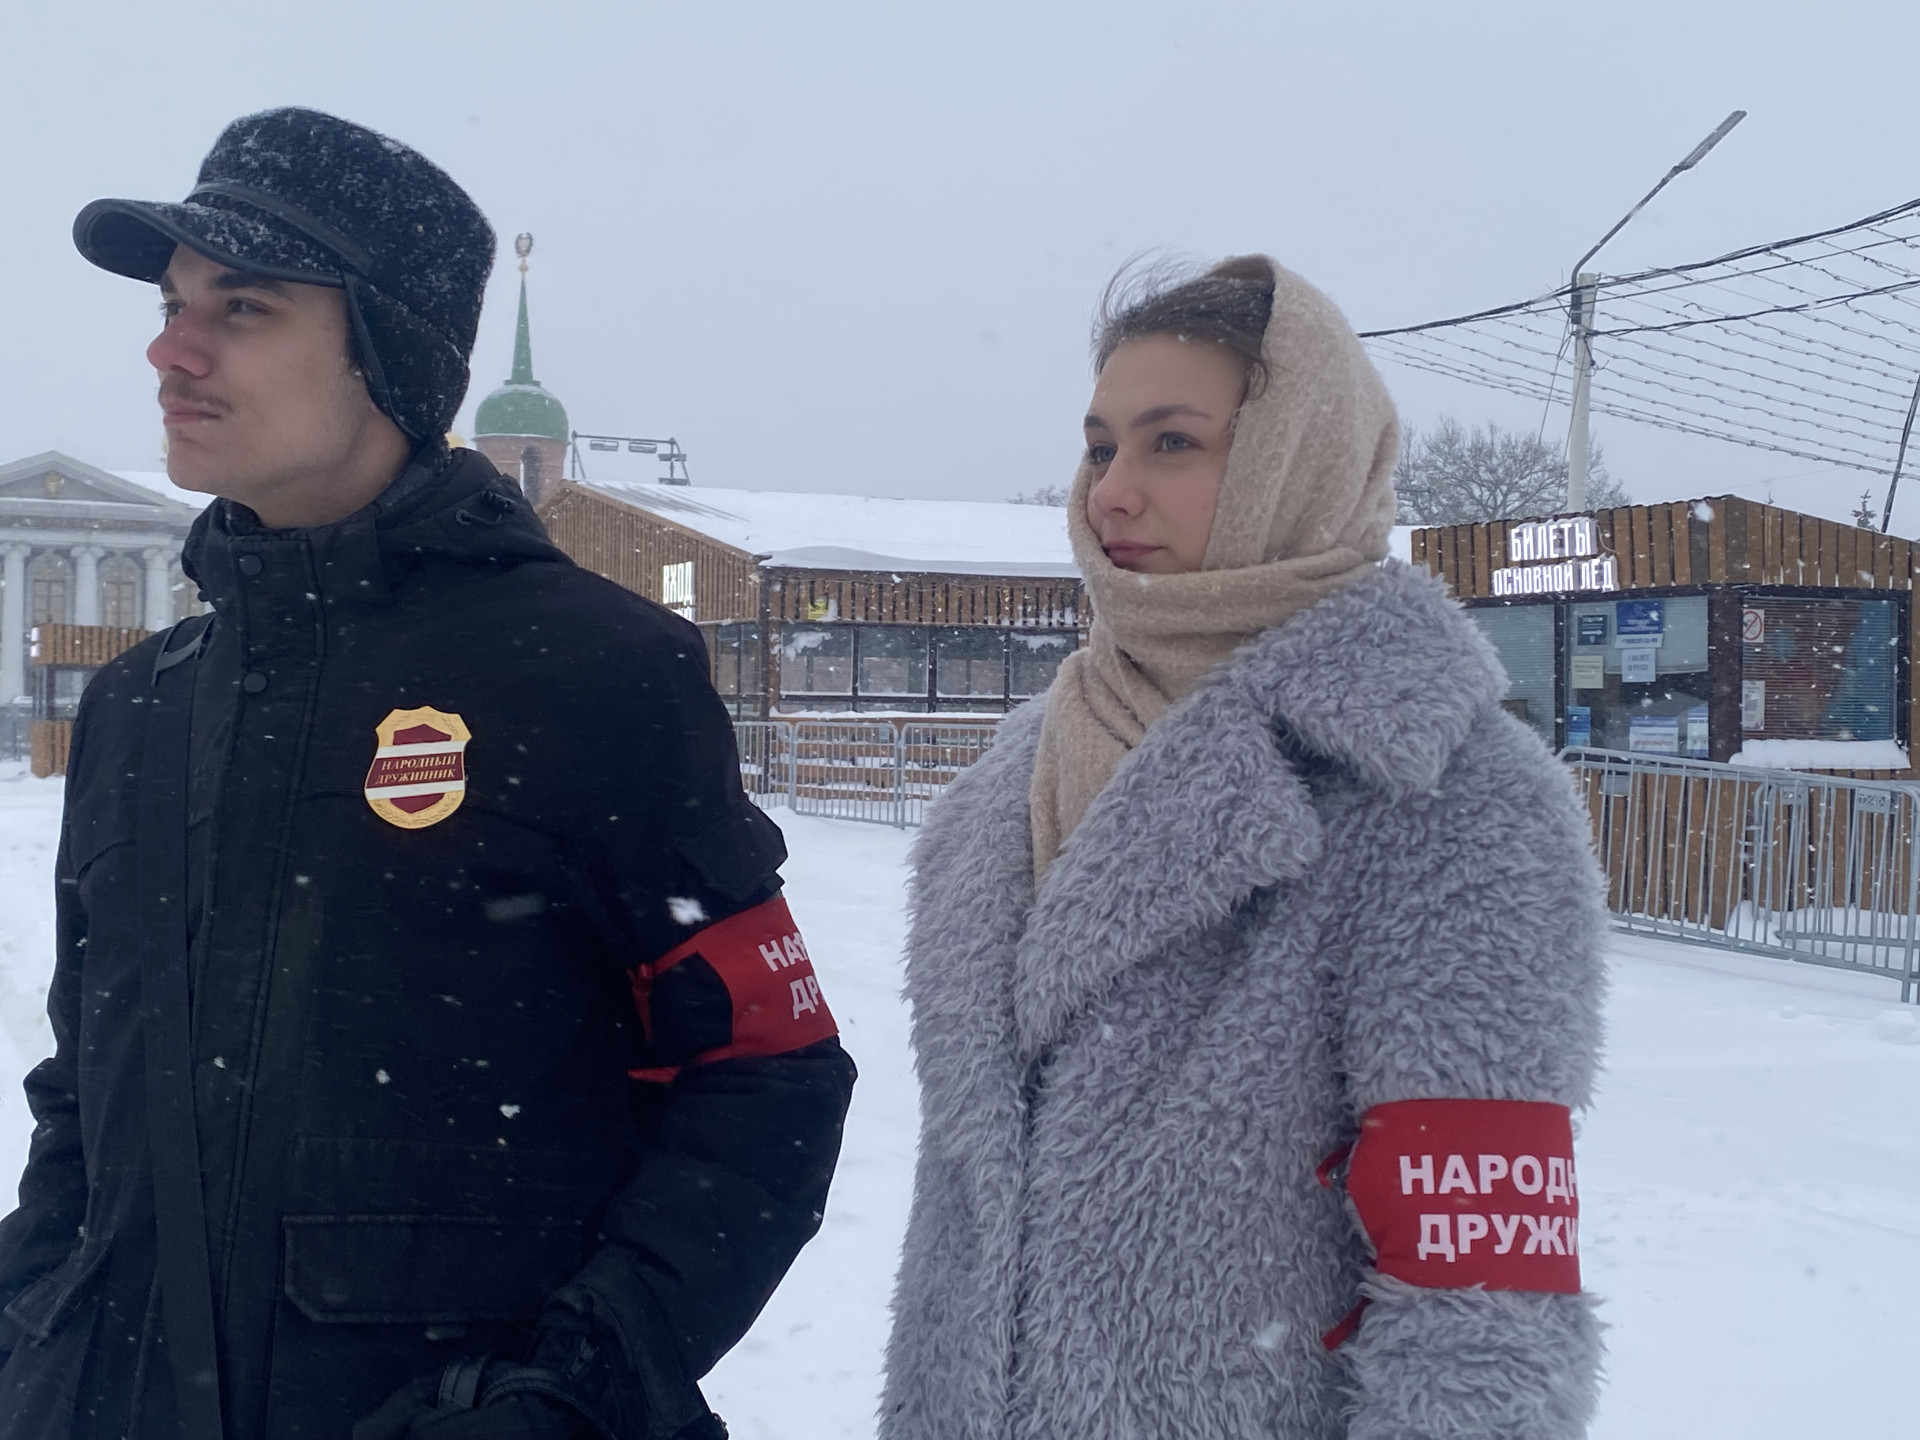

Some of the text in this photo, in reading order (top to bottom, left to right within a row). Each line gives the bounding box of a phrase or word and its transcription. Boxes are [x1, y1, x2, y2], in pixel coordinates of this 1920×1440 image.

[1510, 521, 1592, 562] БИЛЕТЫ
[663, 561, 694, 605] ВХОД
[1493, 559, 1575, 596] ОСНОВНОЙ
[374, 768, 457, 786] ДРУЖИННИК
[381, 754, 457, 772] НАРОДНЫЙ
[789, 975, 826, 1020] ДР
